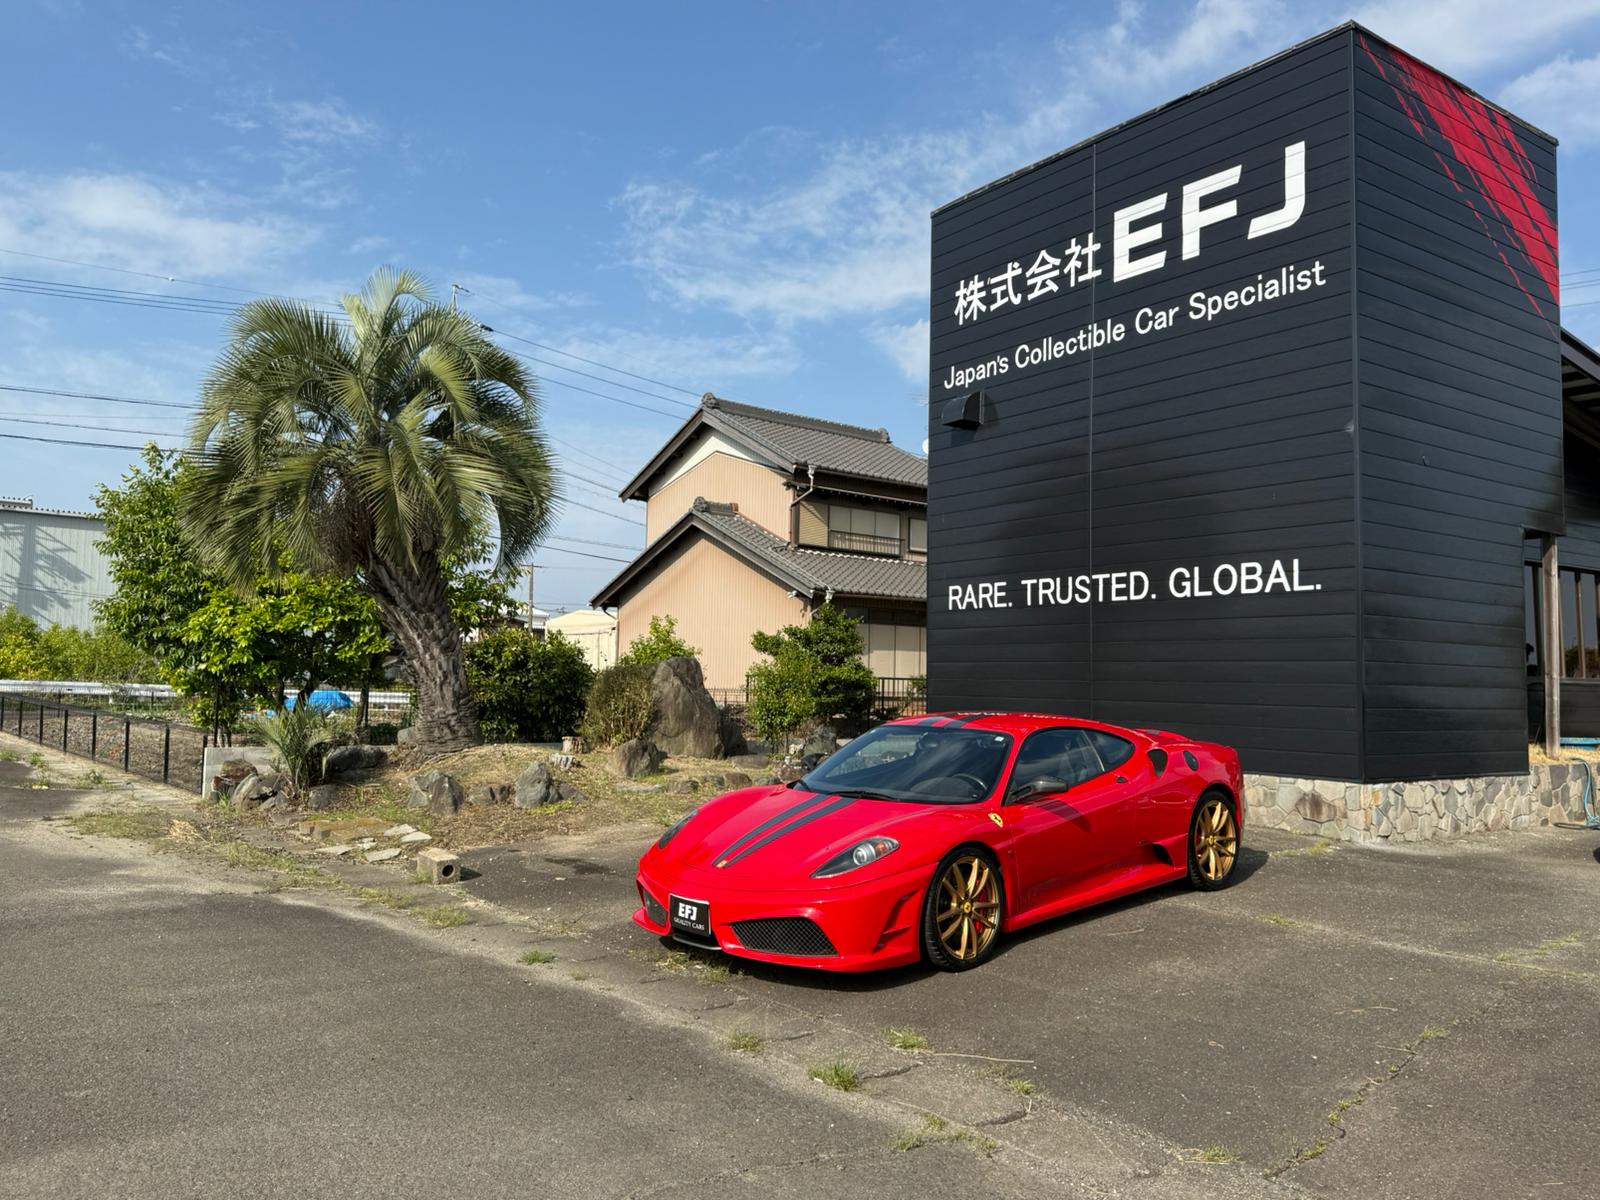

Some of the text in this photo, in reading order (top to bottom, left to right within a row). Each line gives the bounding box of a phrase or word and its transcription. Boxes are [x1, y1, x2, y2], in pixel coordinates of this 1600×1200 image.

[953, 140, 1306, 326] 株式会社 EFJ
[943, 260, 1327, 390] Japan's Collectible Car Specialist
[948, 558, 1322, 611] RARE. TRUSTED. GLOBAL.
[678, 902, 698, 921] EFJ
